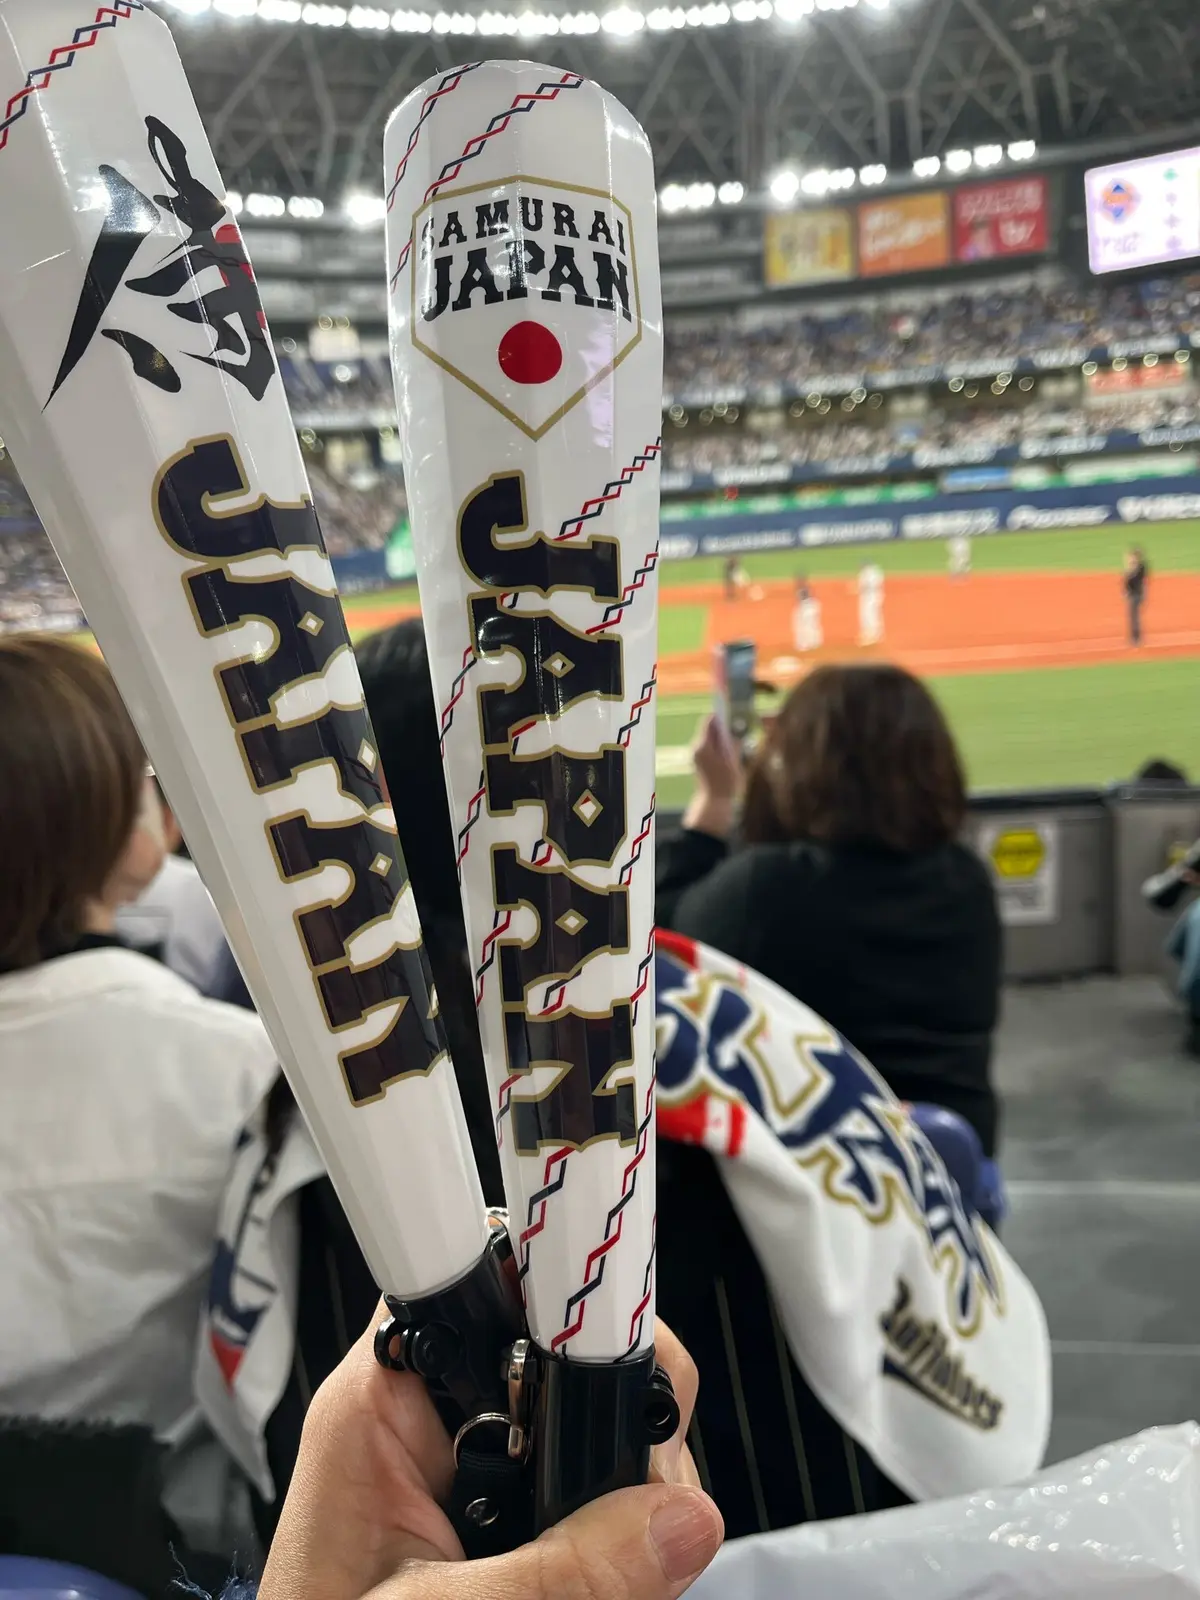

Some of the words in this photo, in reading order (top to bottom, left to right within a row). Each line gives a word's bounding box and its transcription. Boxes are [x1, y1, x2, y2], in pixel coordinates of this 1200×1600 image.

[421, 197, 627, 260] SAMURAI
[421, 239, 632, 322] JAPAN
[152, 433, 451, 1108] JAPAN
[456, 470, 638, 1157] JAPAN
